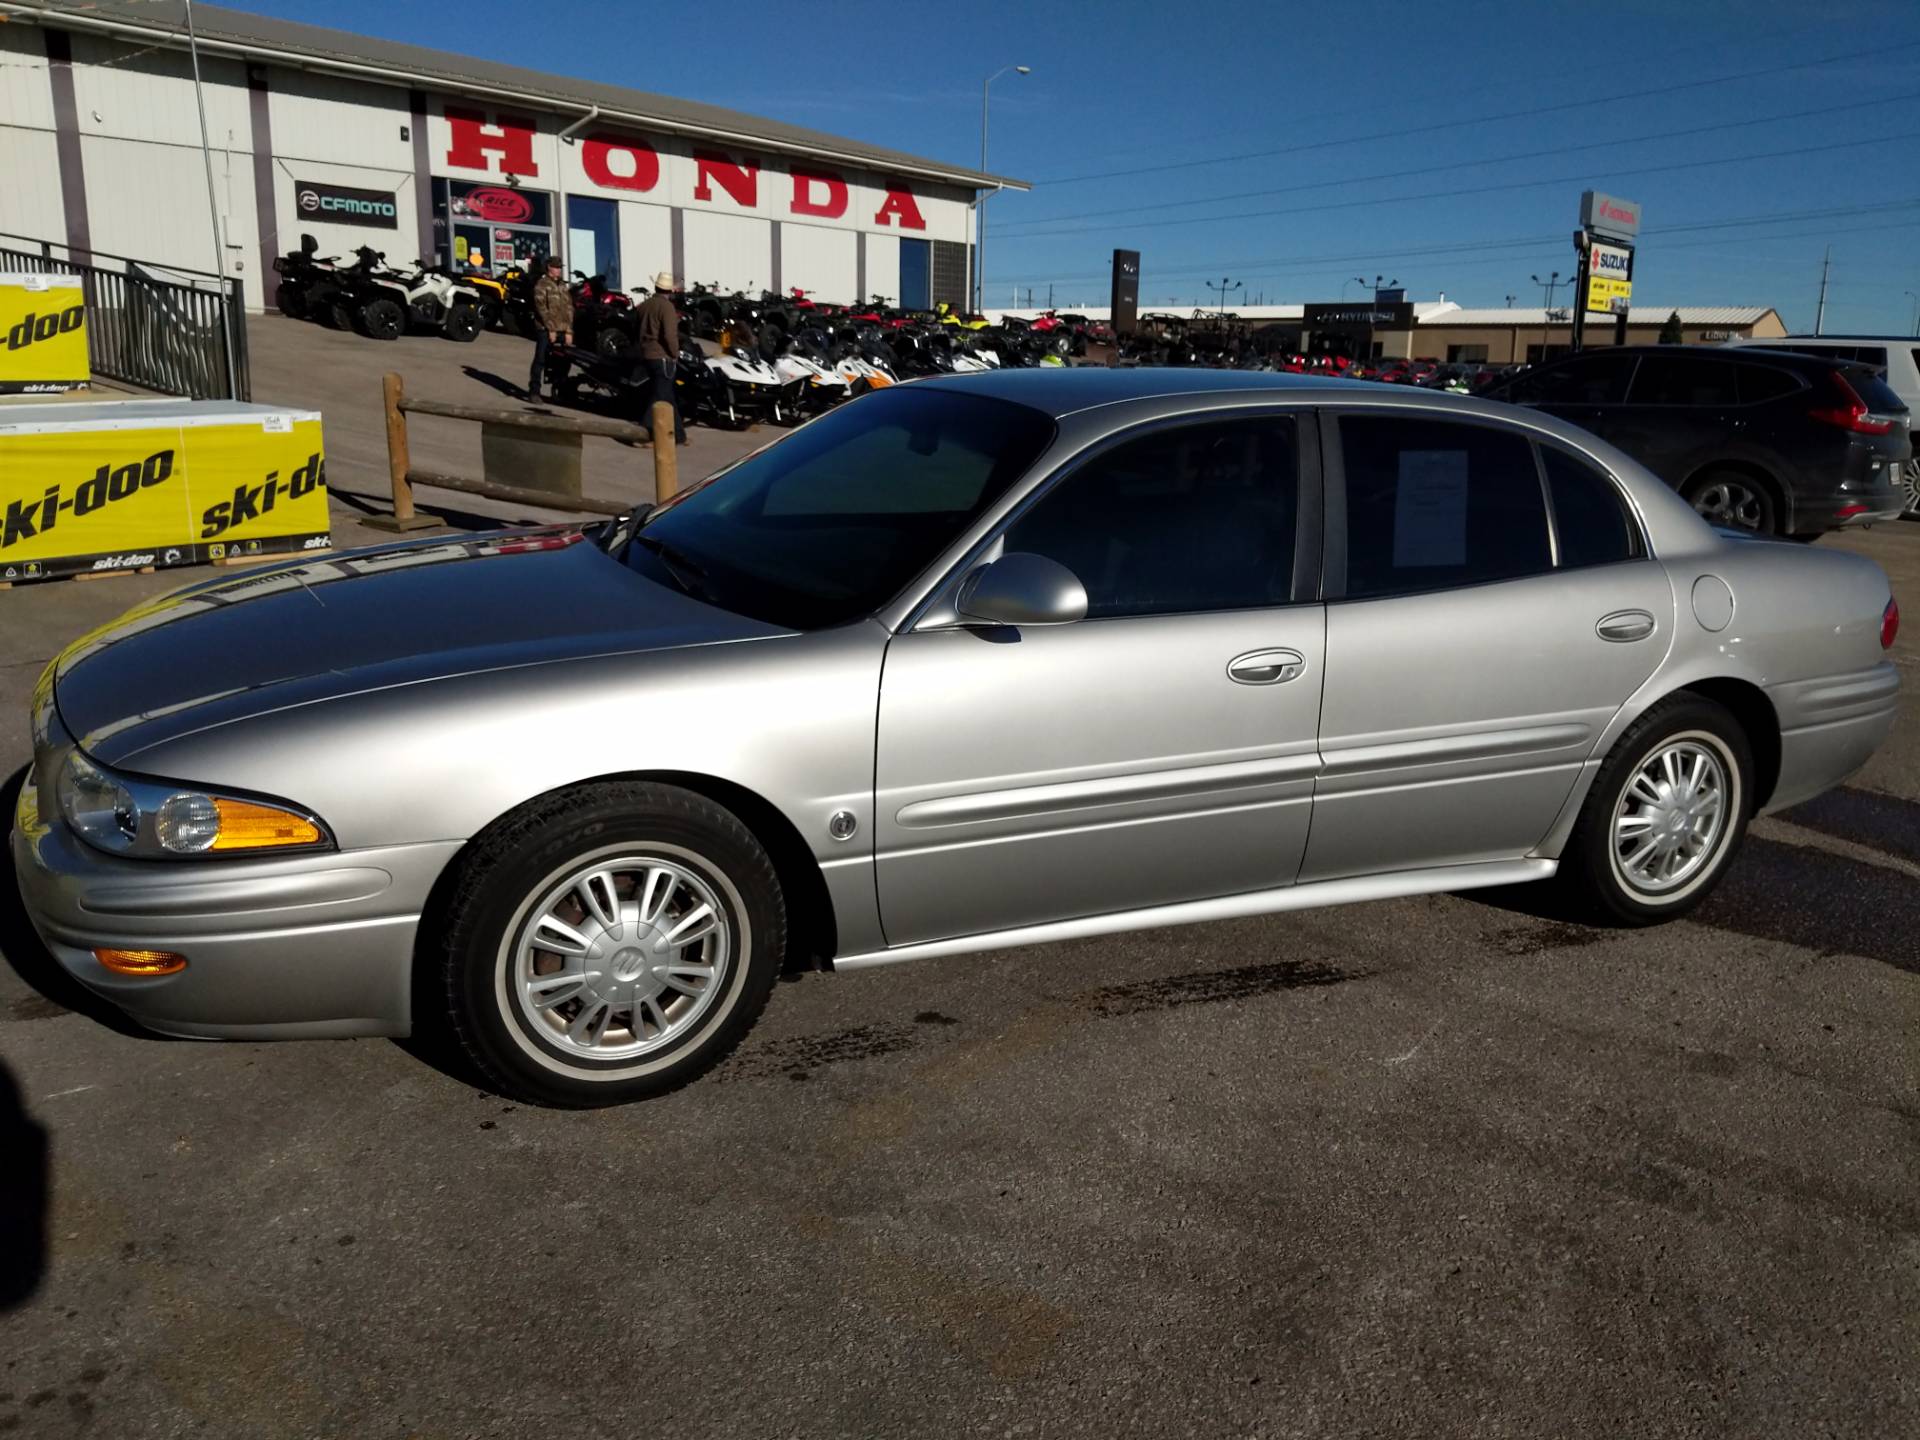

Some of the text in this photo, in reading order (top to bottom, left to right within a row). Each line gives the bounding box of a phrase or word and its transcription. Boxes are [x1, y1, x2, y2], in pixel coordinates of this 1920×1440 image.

[444, 106, 926, 230] HONDA
[319, 195, 395, 217] CFMOTO
[1600, 253, 1629, 272] SUZUKI
[303, 536, 332, 550] ski-
[92, 554, 155, 571] ski-doo
